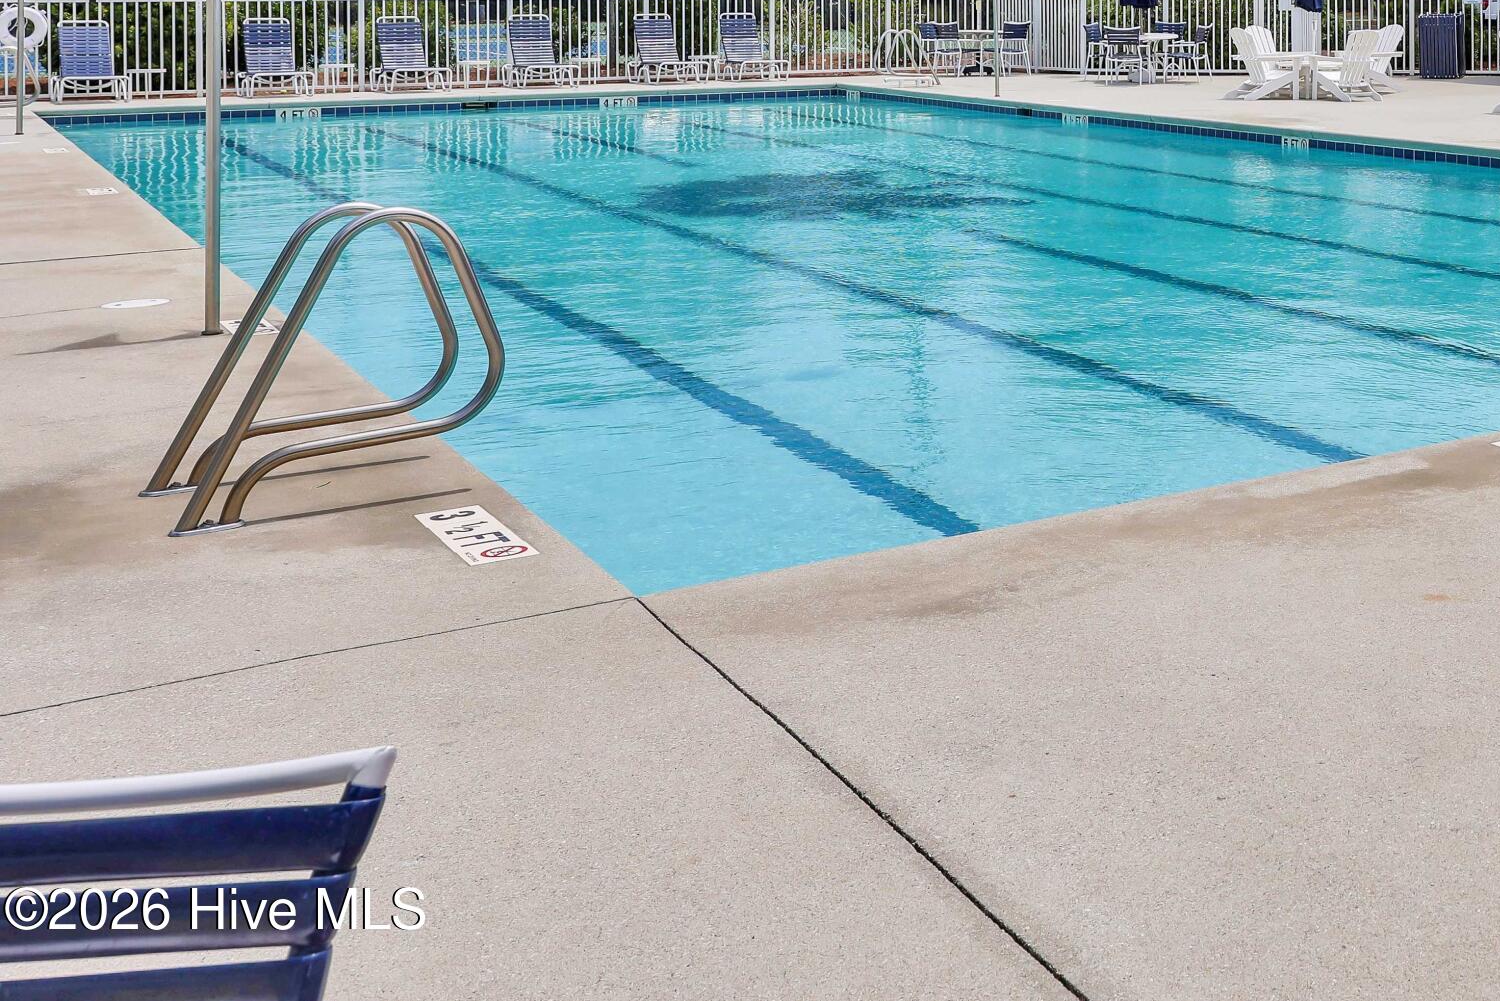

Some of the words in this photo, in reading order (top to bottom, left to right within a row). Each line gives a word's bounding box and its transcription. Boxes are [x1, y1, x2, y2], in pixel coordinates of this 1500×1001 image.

[603, 98, 609, 108] 4
[613, 98, 623, 108] FT
[280, 110, 286, 119] 4
[292, 110, 304, 119] FT
[429, 510, 476, 521] 3
[452, 531, 511, 547] FT
